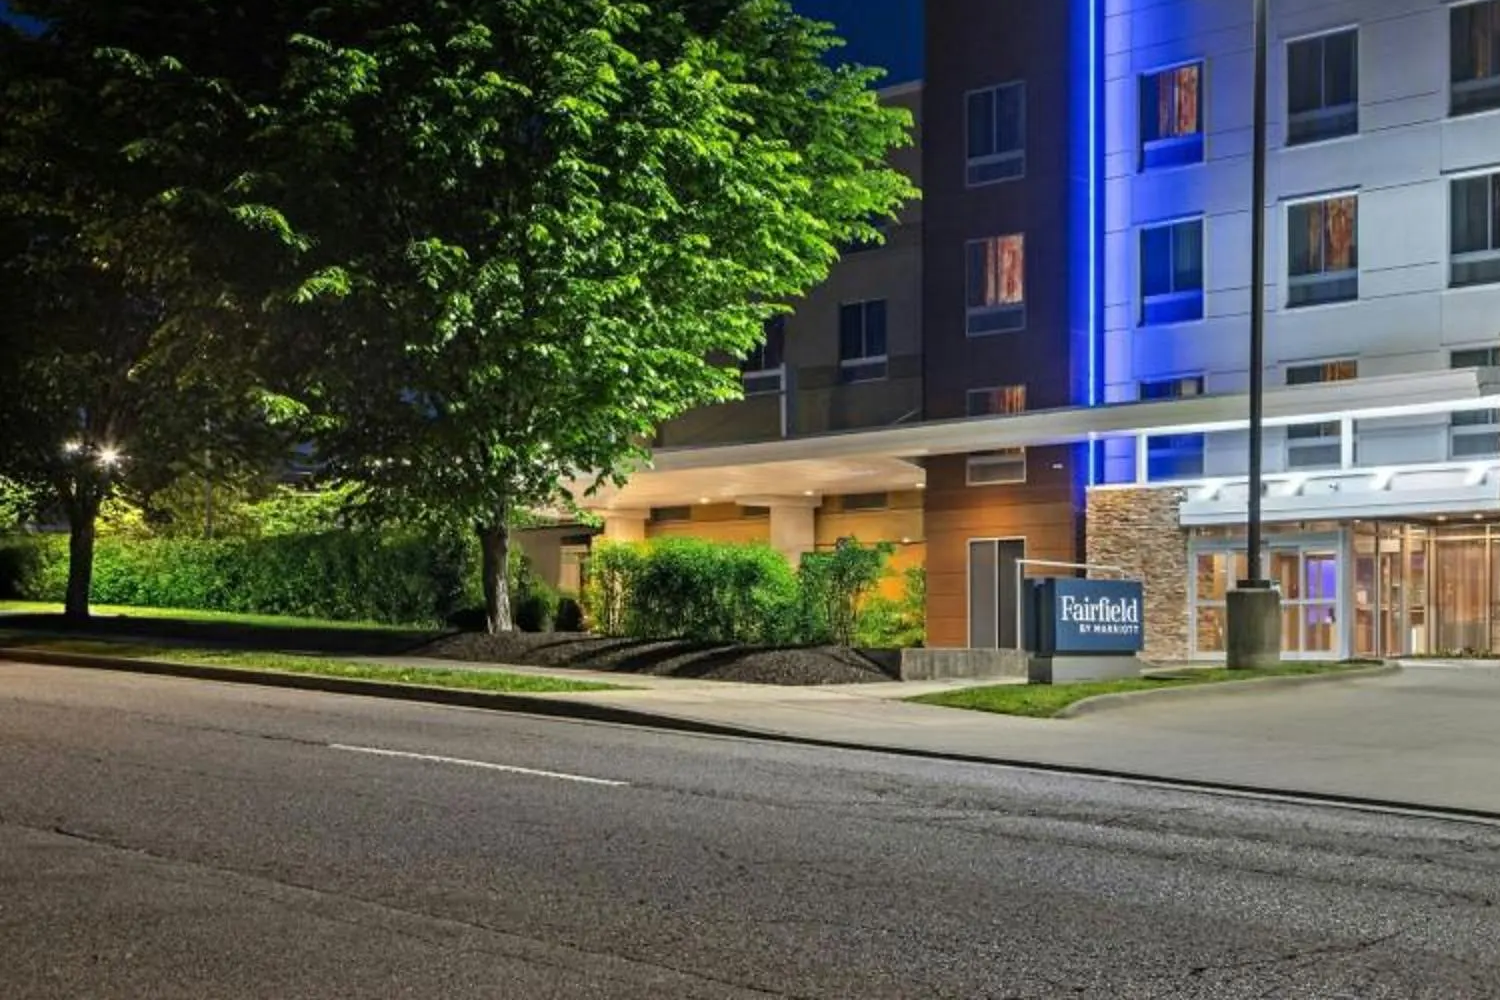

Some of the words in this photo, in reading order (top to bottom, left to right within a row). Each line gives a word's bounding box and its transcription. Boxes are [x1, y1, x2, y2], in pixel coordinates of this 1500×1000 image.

[1061, 595, 1139, 622] Fairfield
[1079, 624, 1091, 633] BY
[1093, 624, 1139, 634] MARRIOTT
